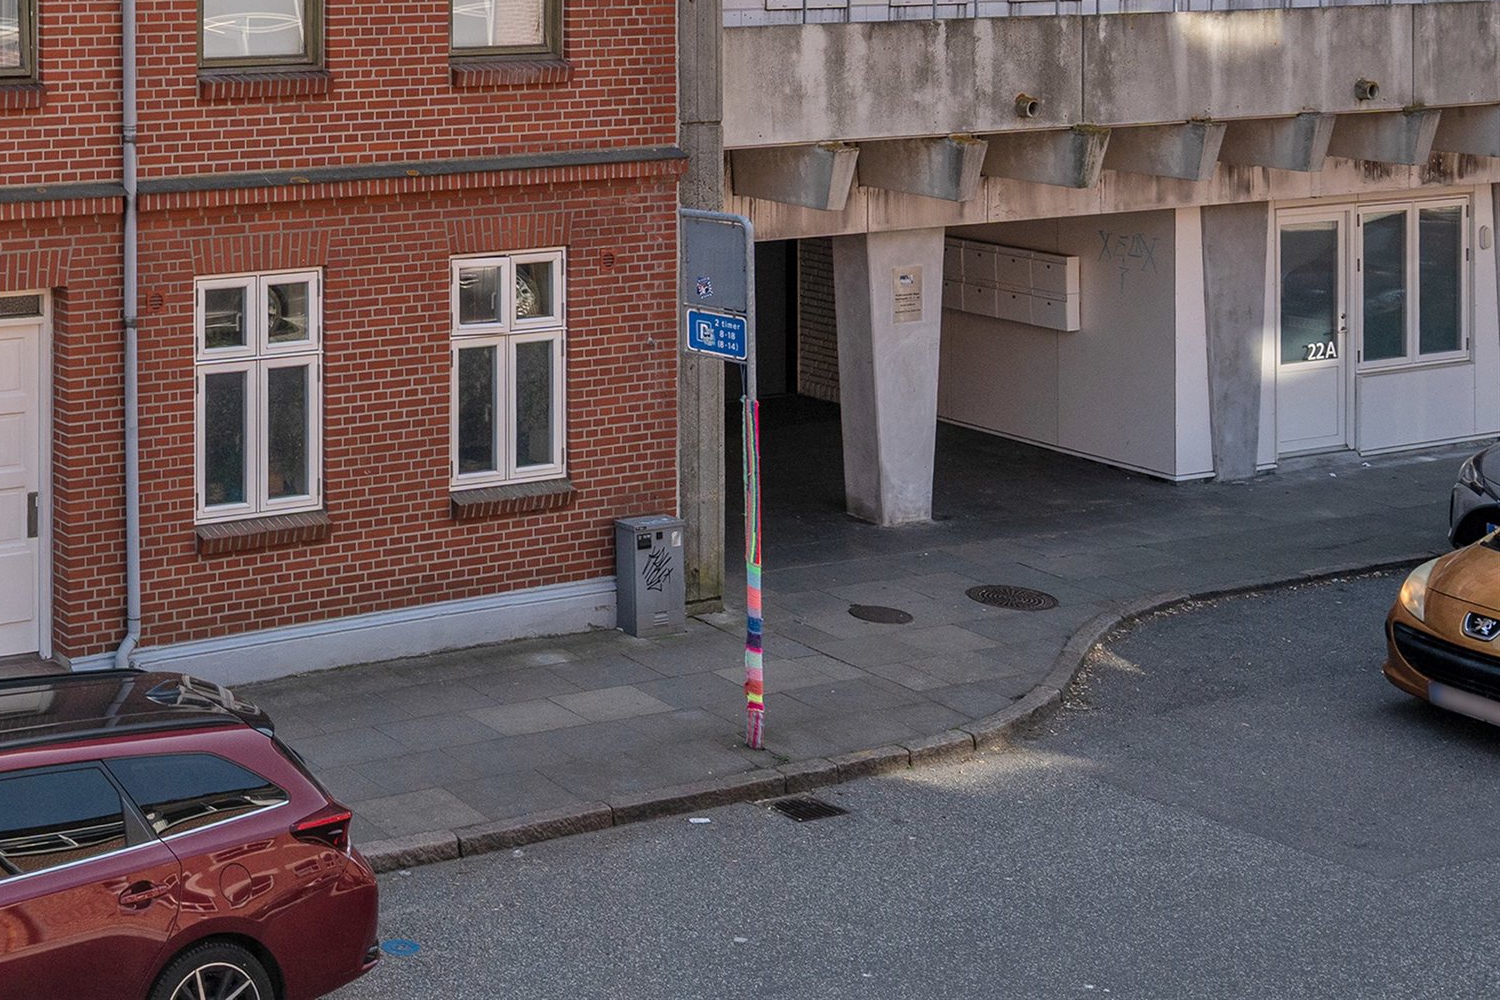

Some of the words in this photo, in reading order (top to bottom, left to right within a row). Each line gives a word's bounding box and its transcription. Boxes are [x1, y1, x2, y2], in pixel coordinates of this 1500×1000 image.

[714, 318, 720, 327] 2
[721, 320, 740, 330] timer
[1307, 341, 1337, 361] 22A
